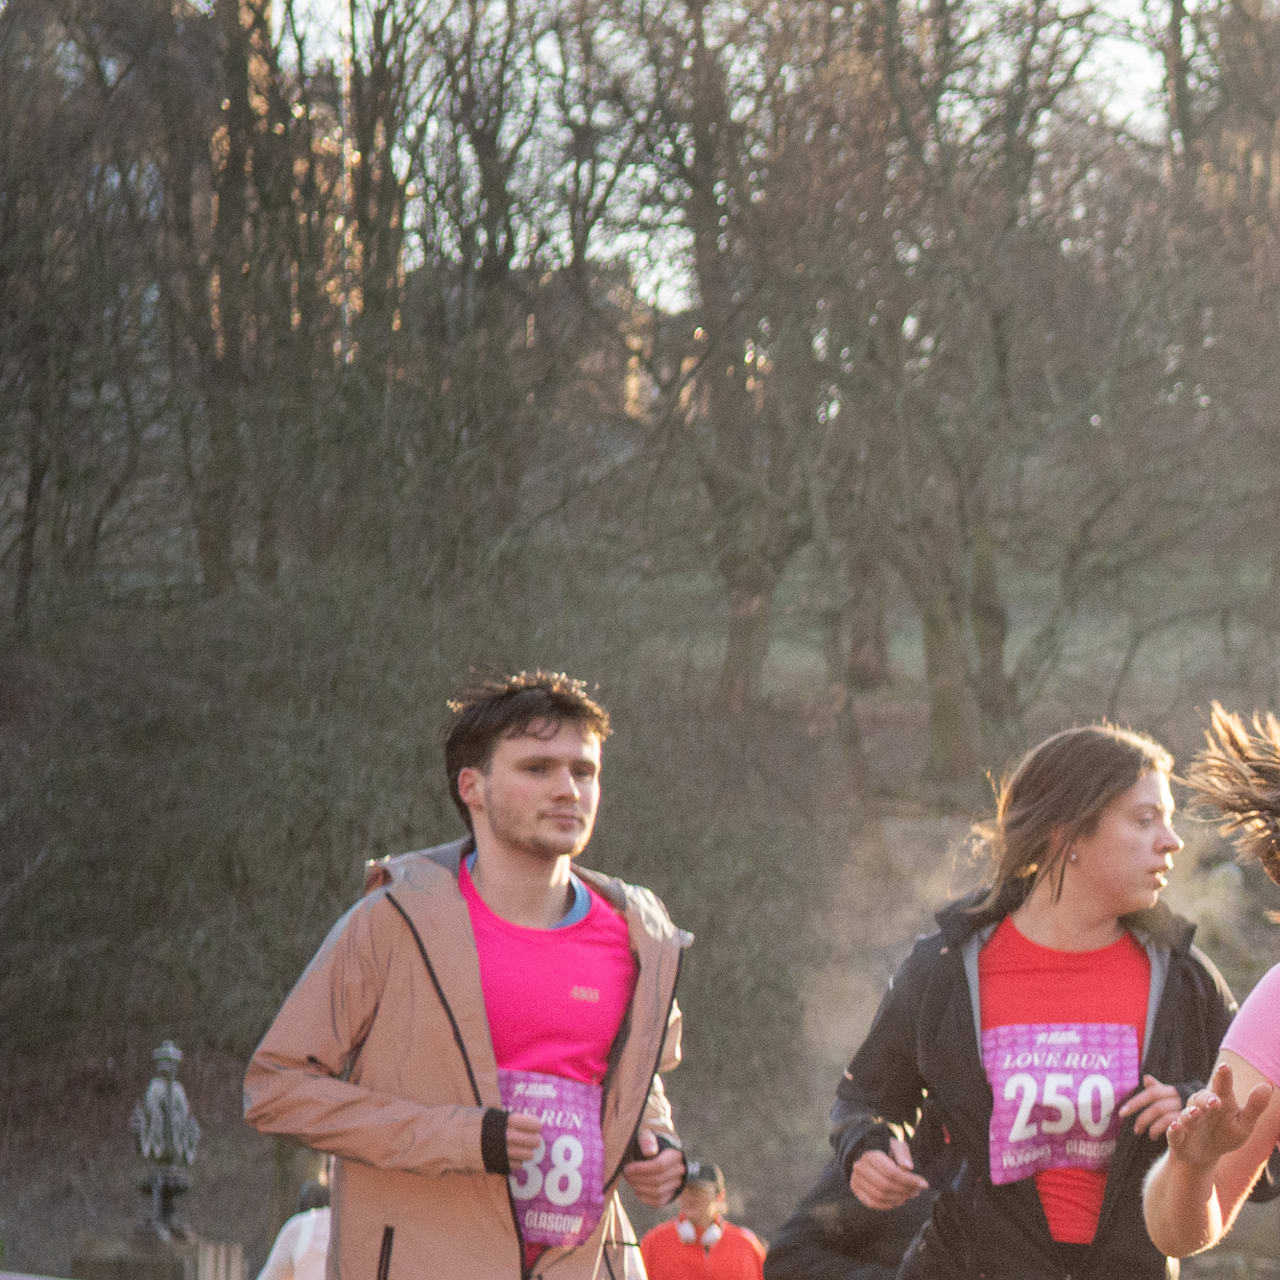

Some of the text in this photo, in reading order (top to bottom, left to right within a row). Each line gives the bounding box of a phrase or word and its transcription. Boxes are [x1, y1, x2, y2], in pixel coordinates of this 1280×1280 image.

[1002, 1052, 1113, 1070] LOVE RUN
[539, 1109, 584, 1129] RUN
[1003, 1072, 1115, 1143] 250
[524, 1209, 584, 1236] GLASGOW
